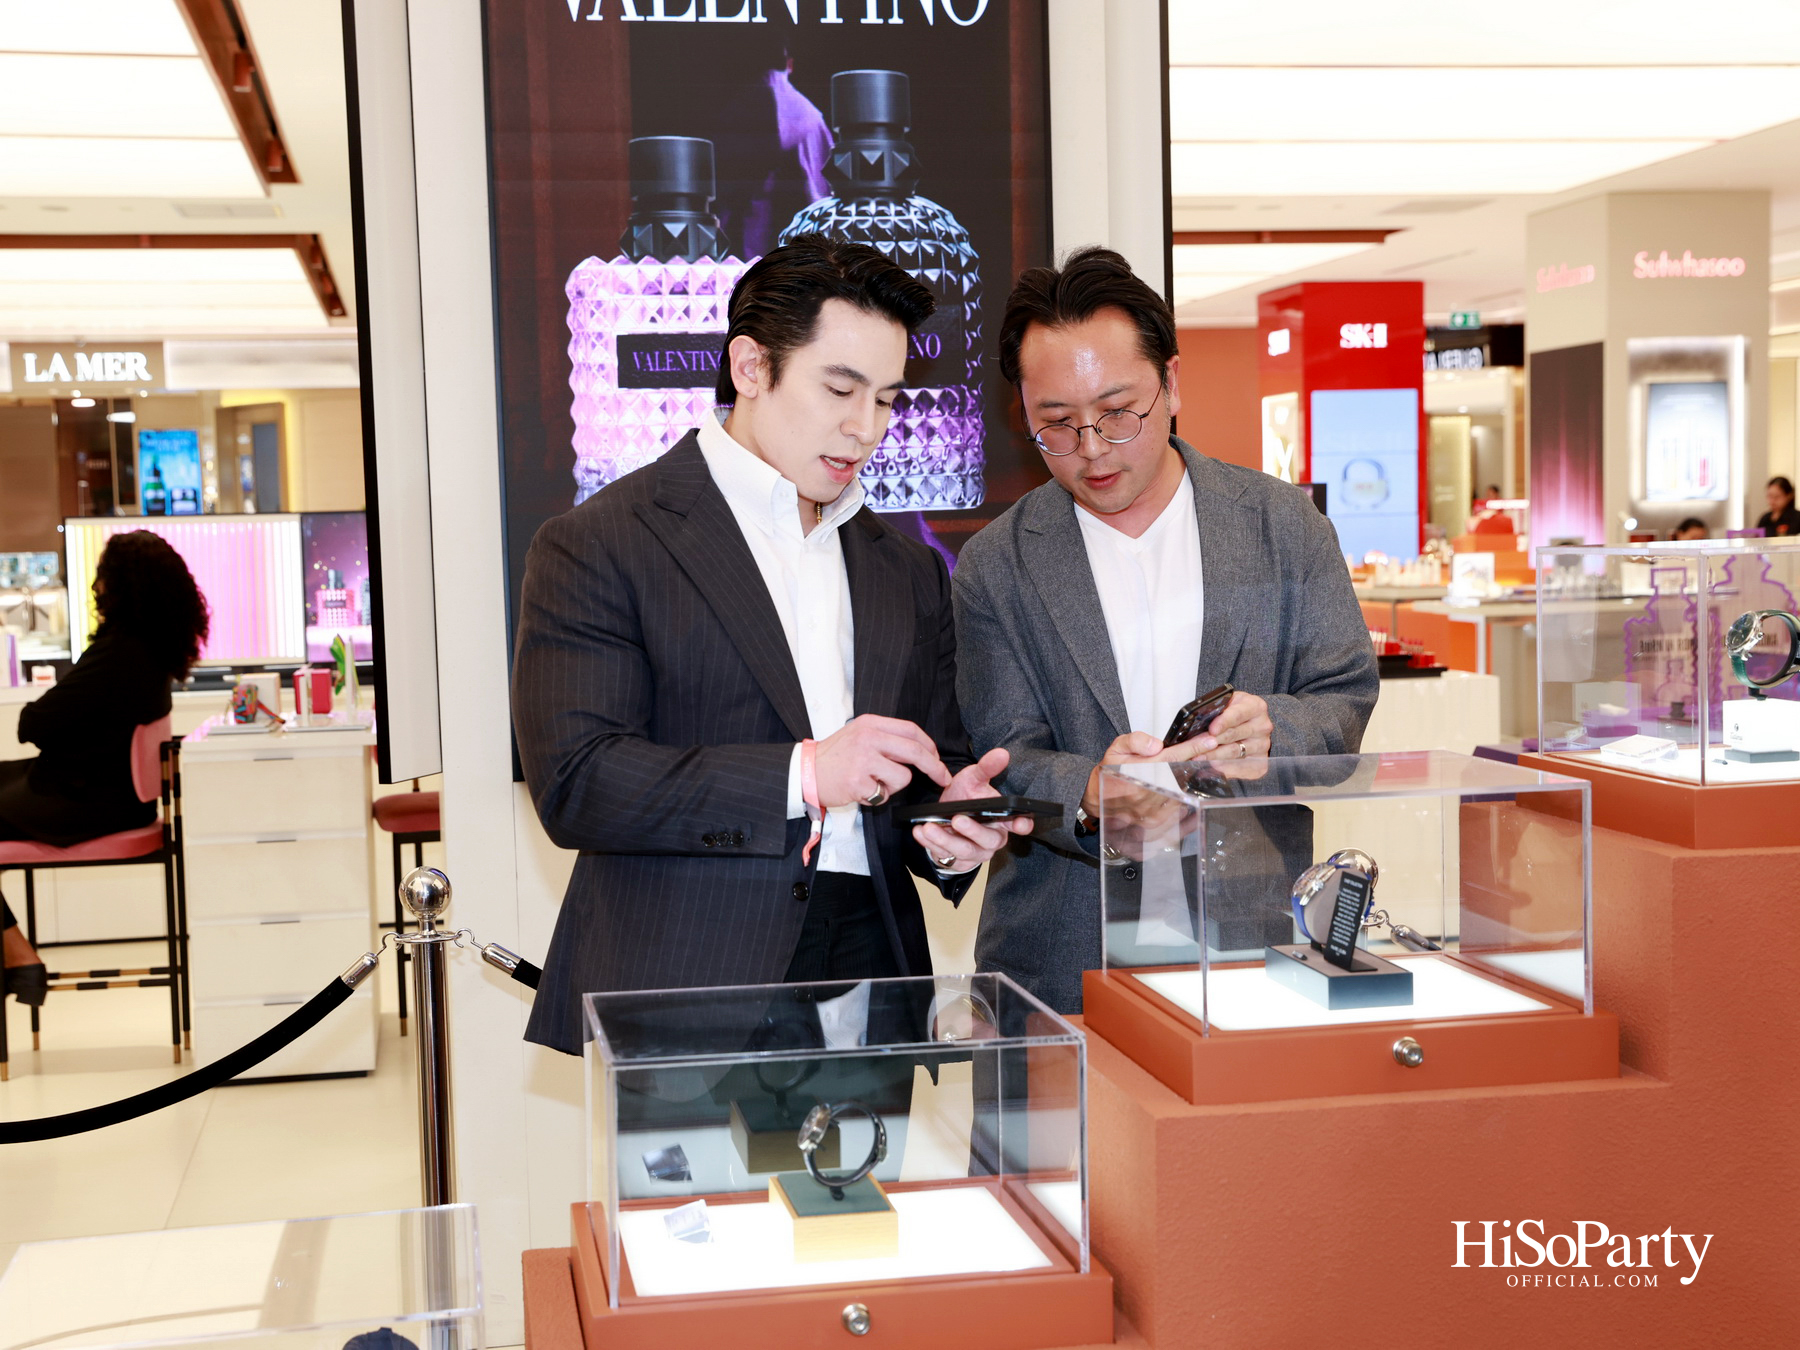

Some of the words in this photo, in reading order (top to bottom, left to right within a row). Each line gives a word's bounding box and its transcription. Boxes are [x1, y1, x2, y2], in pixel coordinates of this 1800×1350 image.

[23, 352, 73, 382] LA
[74, 352, 153, 382] MER
[633, 350, 722, 372] VALENTIN
